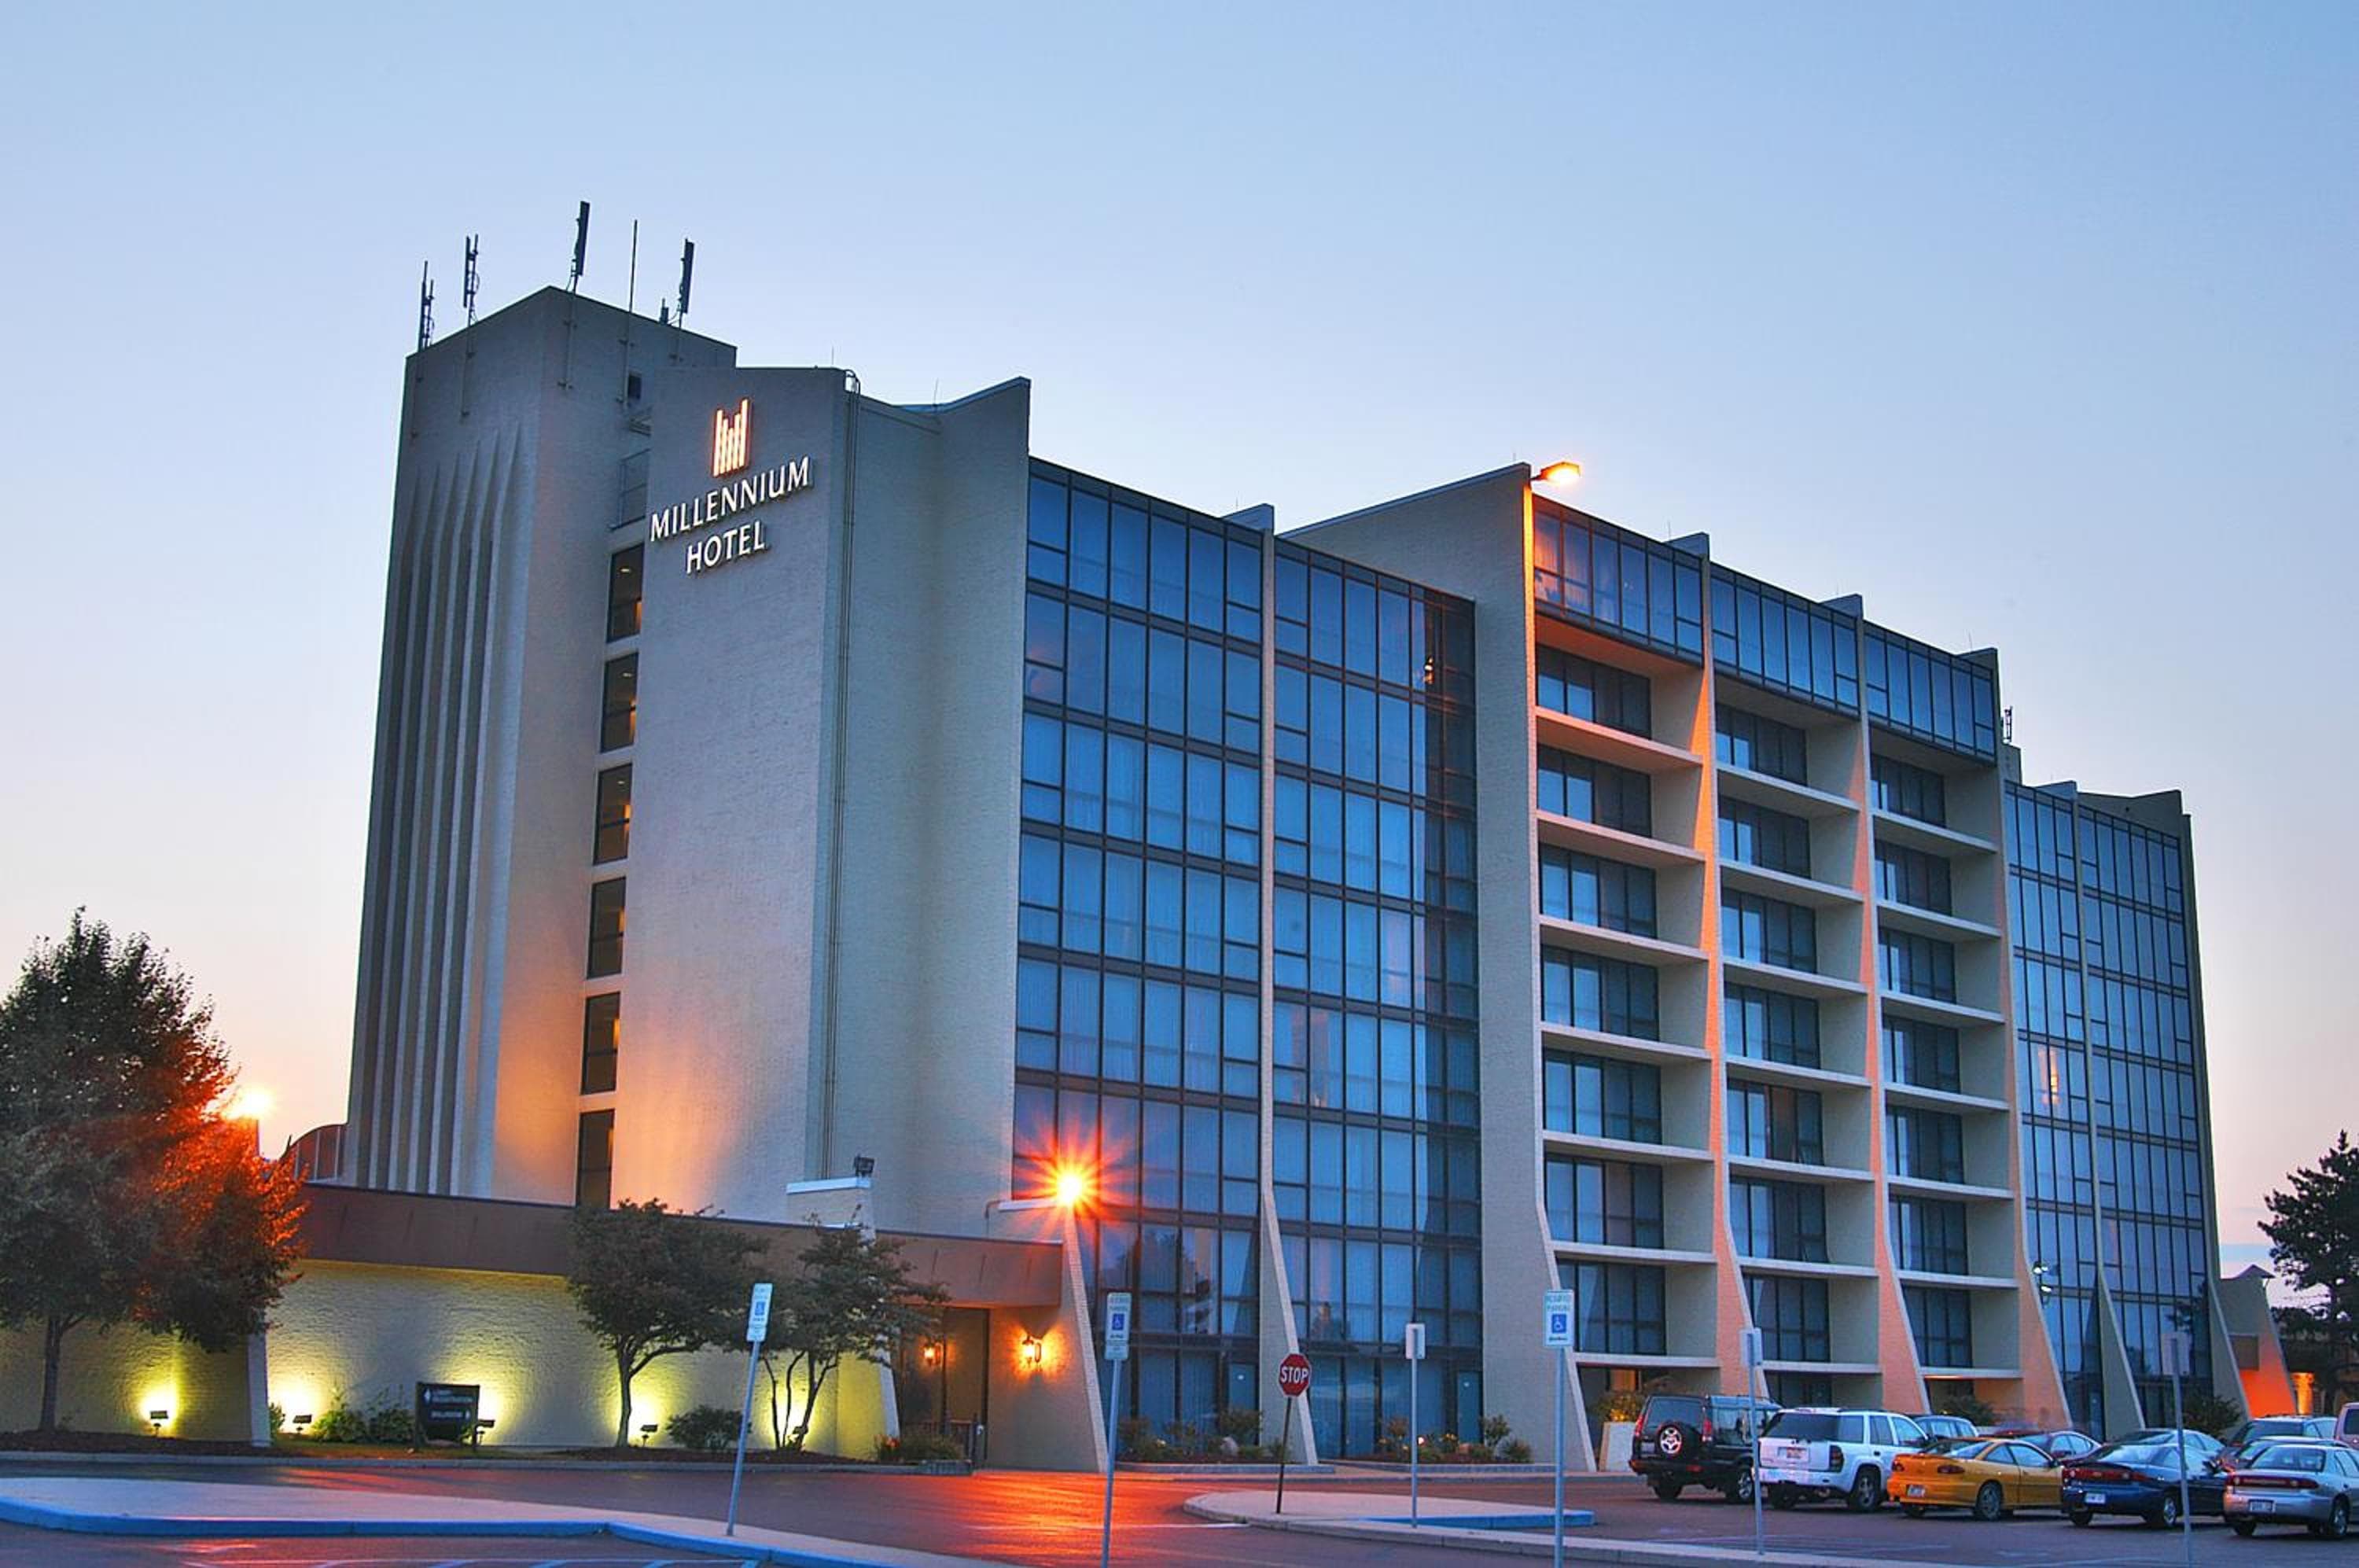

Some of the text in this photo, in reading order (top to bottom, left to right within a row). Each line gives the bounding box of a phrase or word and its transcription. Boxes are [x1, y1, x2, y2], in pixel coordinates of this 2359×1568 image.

[650, 456, 809, 542] MILLENNIUM
[686, 521, 765, 573] HOTEL
[1280, 1366, 1309, 1383] STOP
